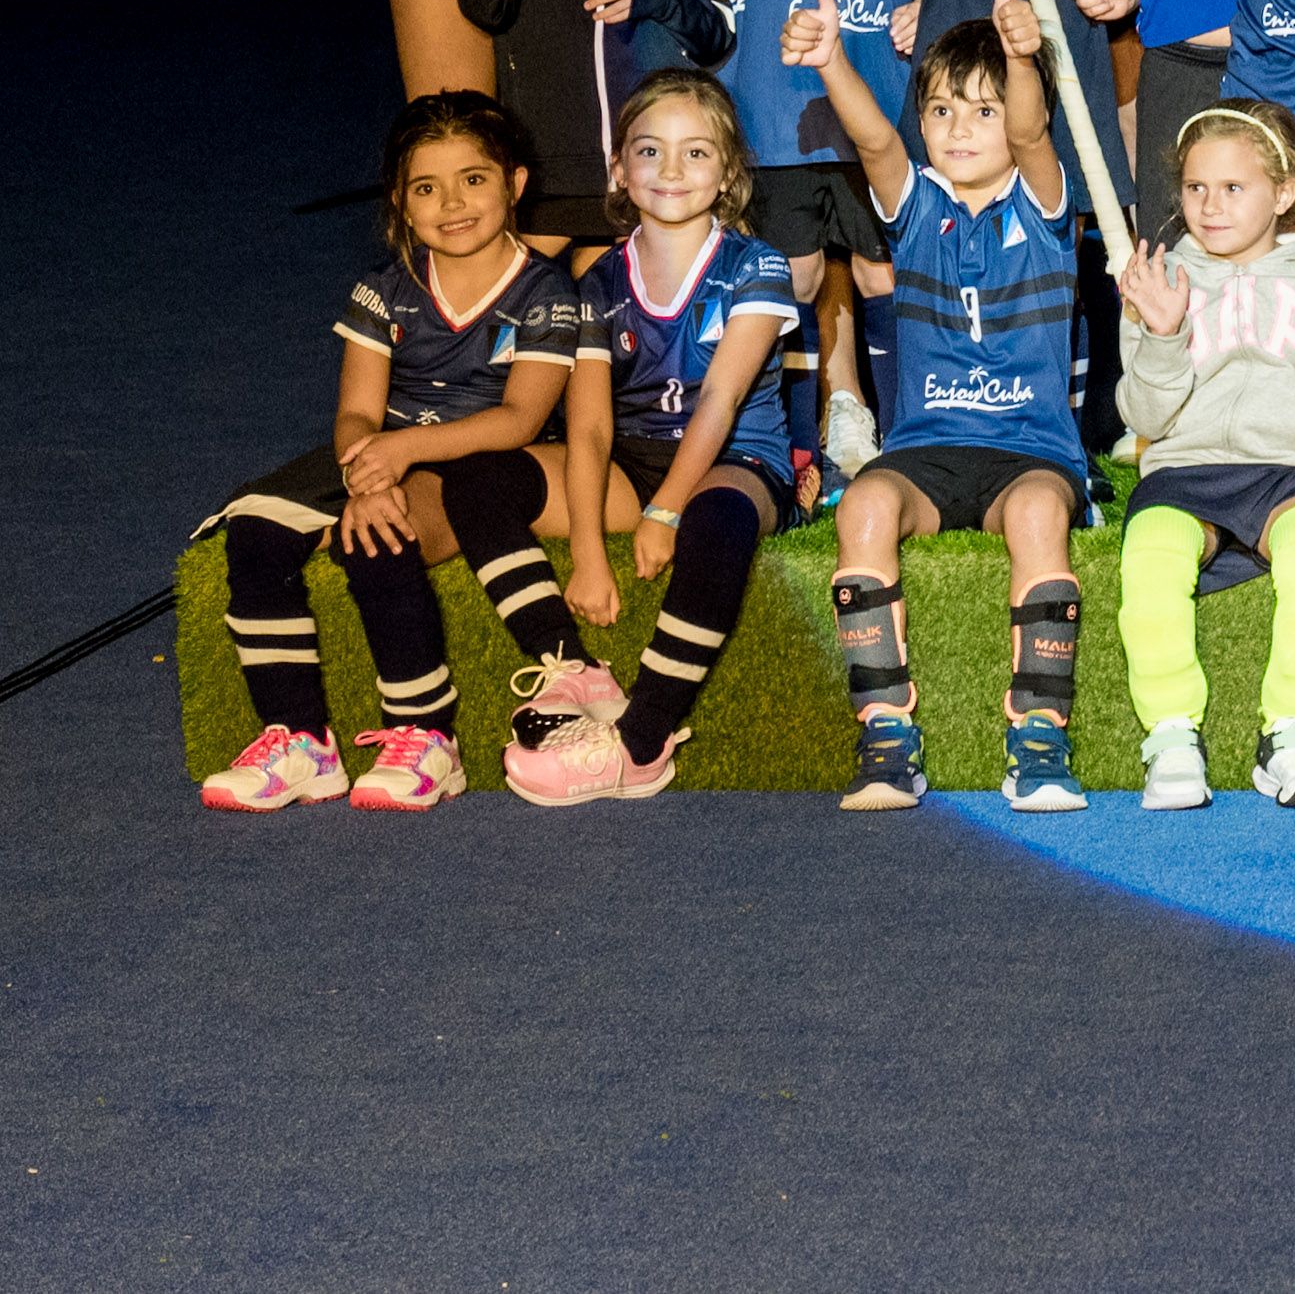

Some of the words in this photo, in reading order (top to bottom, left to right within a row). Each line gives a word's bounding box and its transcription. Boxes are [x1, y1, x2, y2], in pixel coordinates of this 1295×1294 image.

[959, 286, 982, 344] 9
[924, 373, 983, 404] Enjoy
[983, 376, 1035, 404] Cuba
